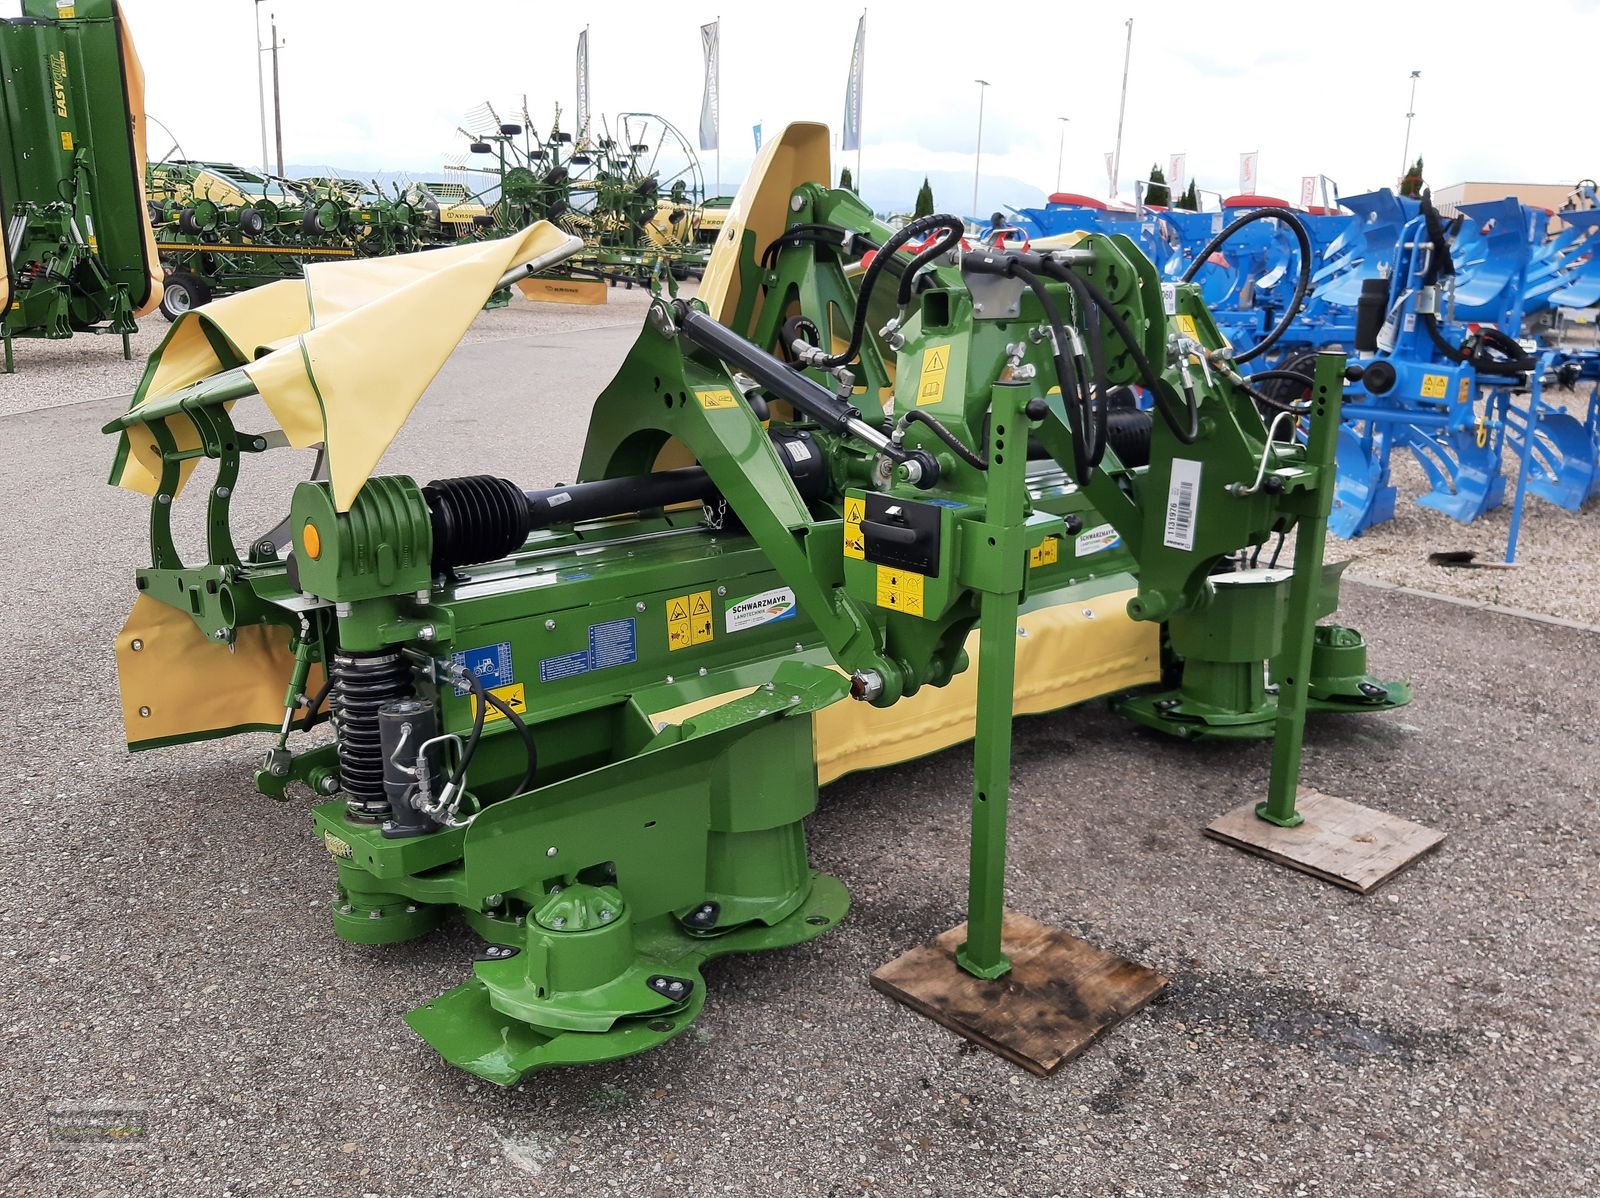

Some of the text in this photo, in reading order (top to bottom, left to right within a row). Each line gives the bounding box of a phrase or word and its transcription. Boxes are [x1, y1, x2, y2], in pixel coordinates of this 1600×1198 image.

[1167, 503, 1178, 535] 1131976
[732, 595, 786, 614] SCHWARZMAYR
[733, 609, 766, 621] LANDTECHNIK
